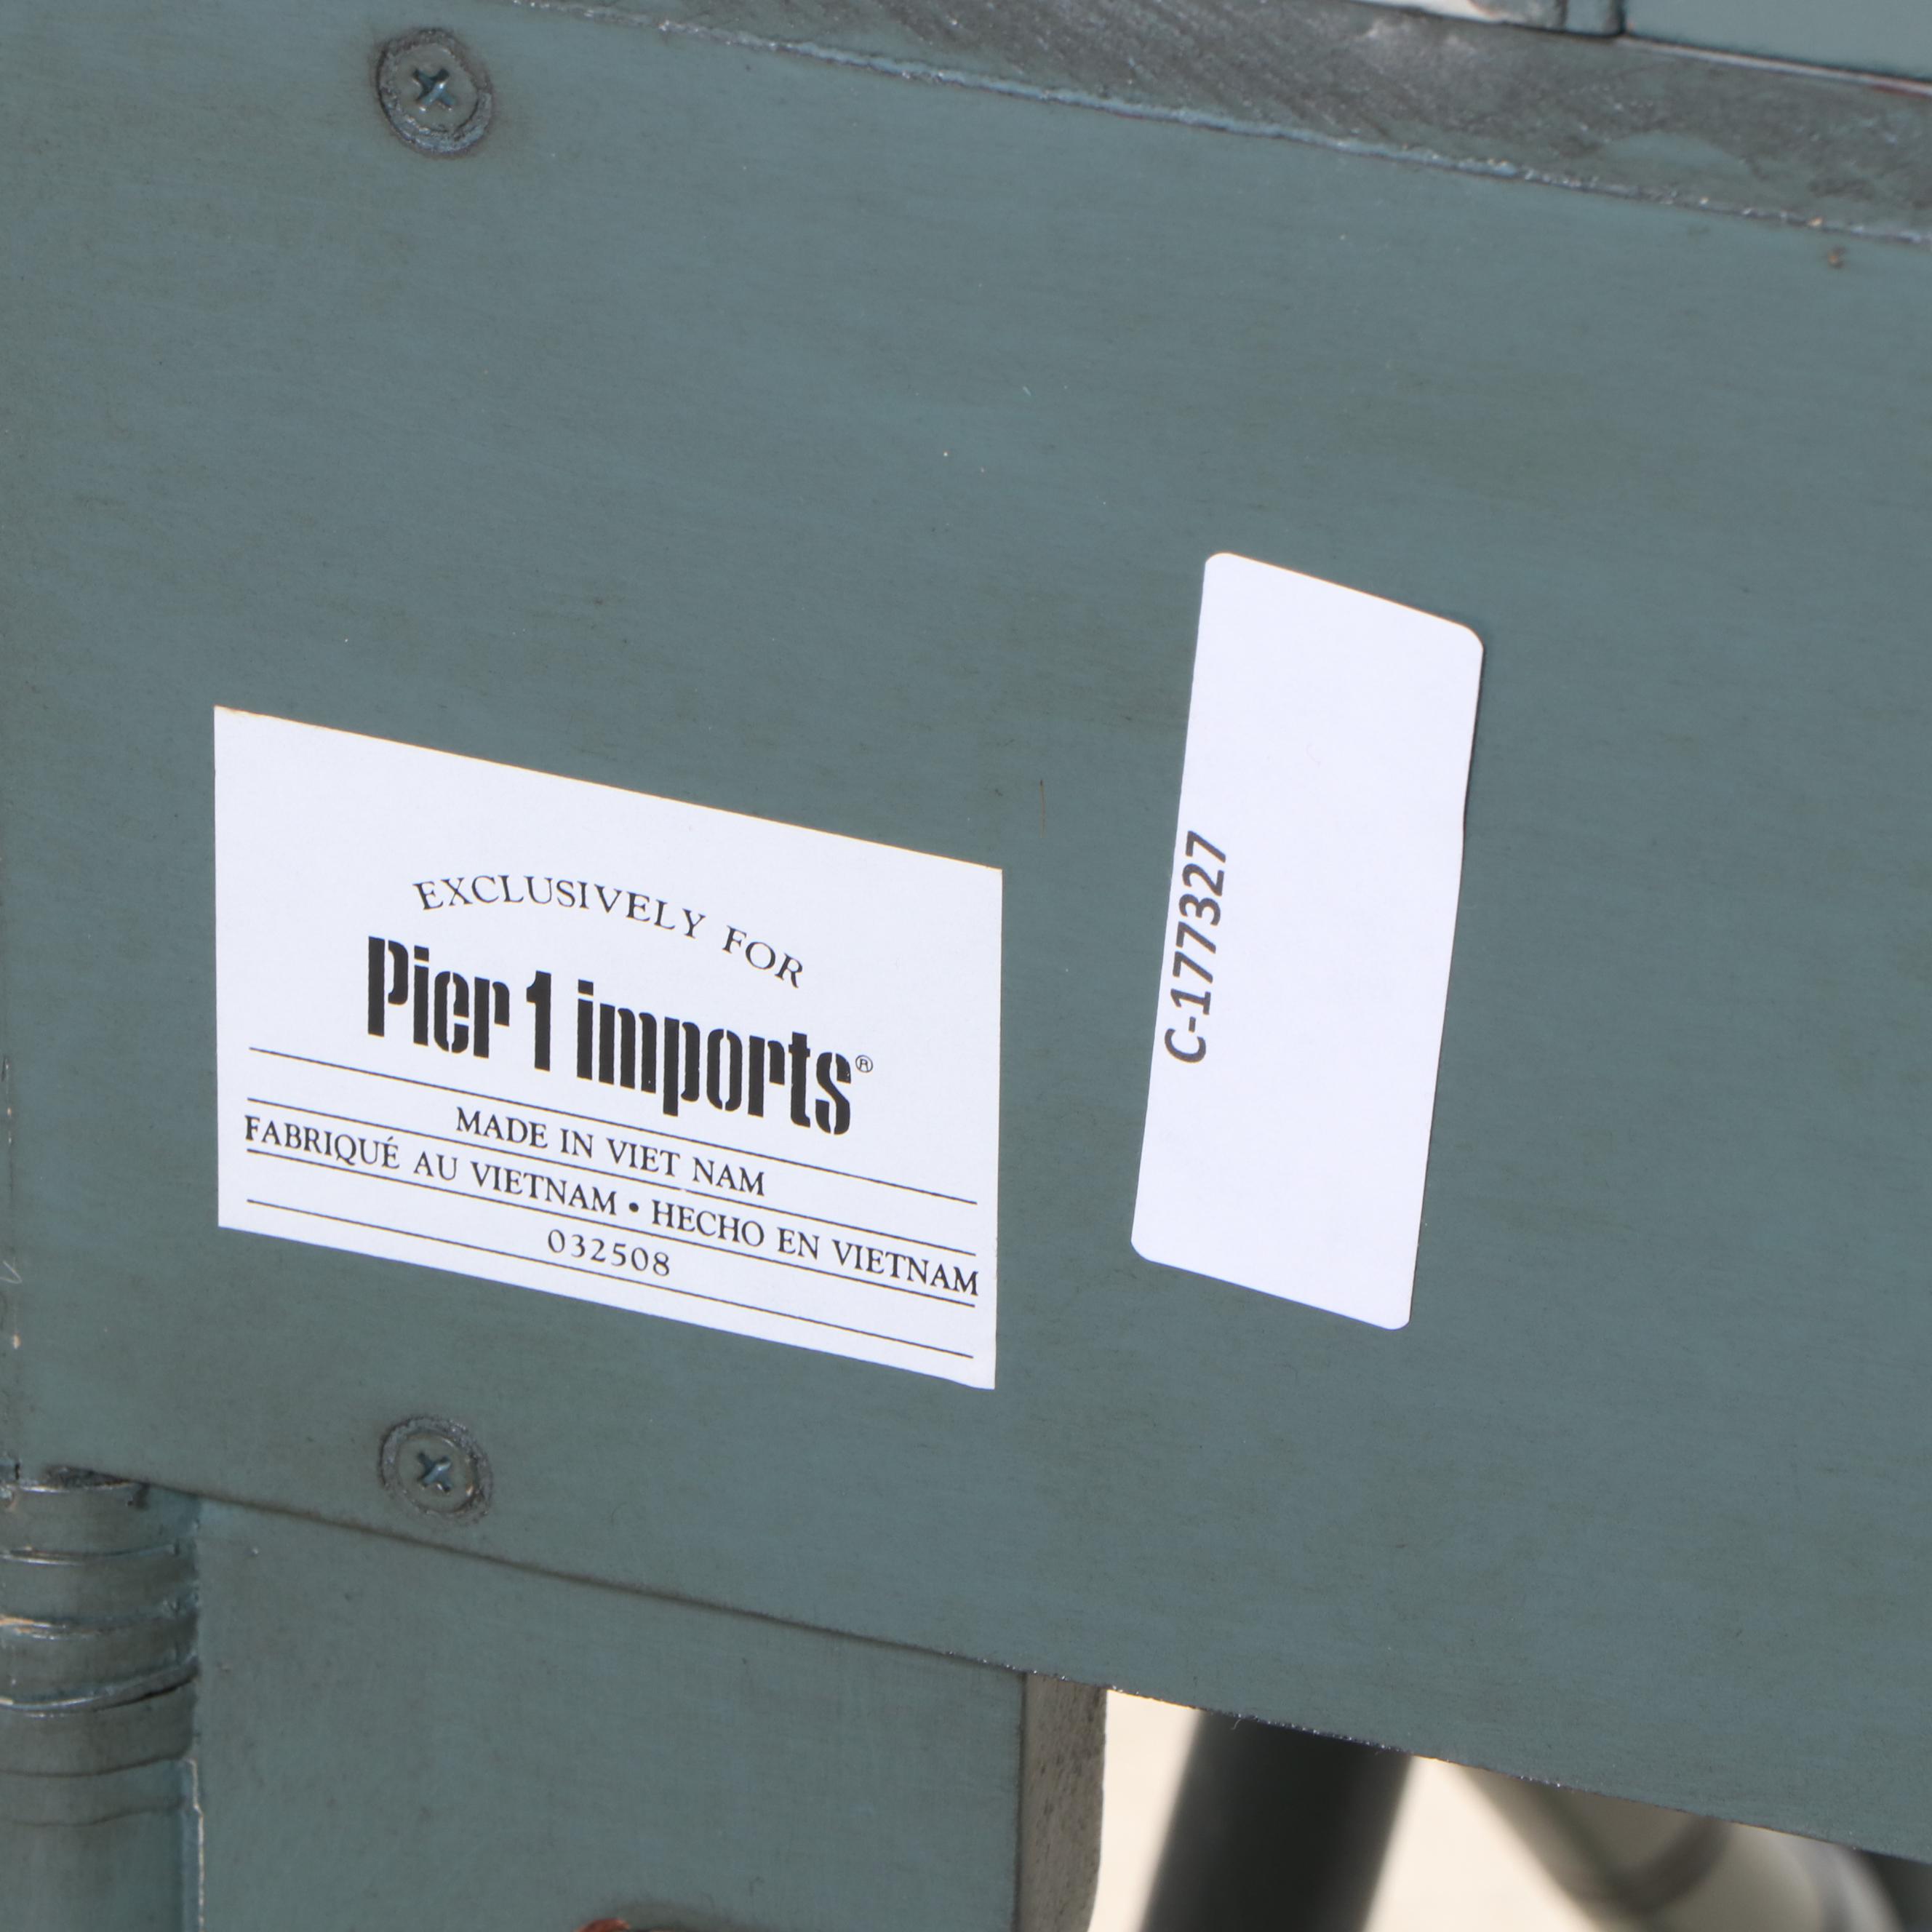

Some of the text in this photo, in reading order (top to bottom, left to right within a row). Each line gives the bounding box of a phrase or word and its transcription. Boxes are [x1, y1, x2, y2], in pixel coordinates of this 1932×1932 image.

[412, 875, 805, 988] EXCLUSIVELY FOR
[1164, 831, 1226, 1063] C-177327
[367, 935, 511, 1059] Pier
[525, 970, 552, 1071] 1
[244, 1115, 979, 1296] FABRIQUÉ AU VIETNAM HECHO EN VIETNAM
[456, 1106, 765, 1197] MADE IN VIET NAM
[547, 1228, 671, 1277] 032508
